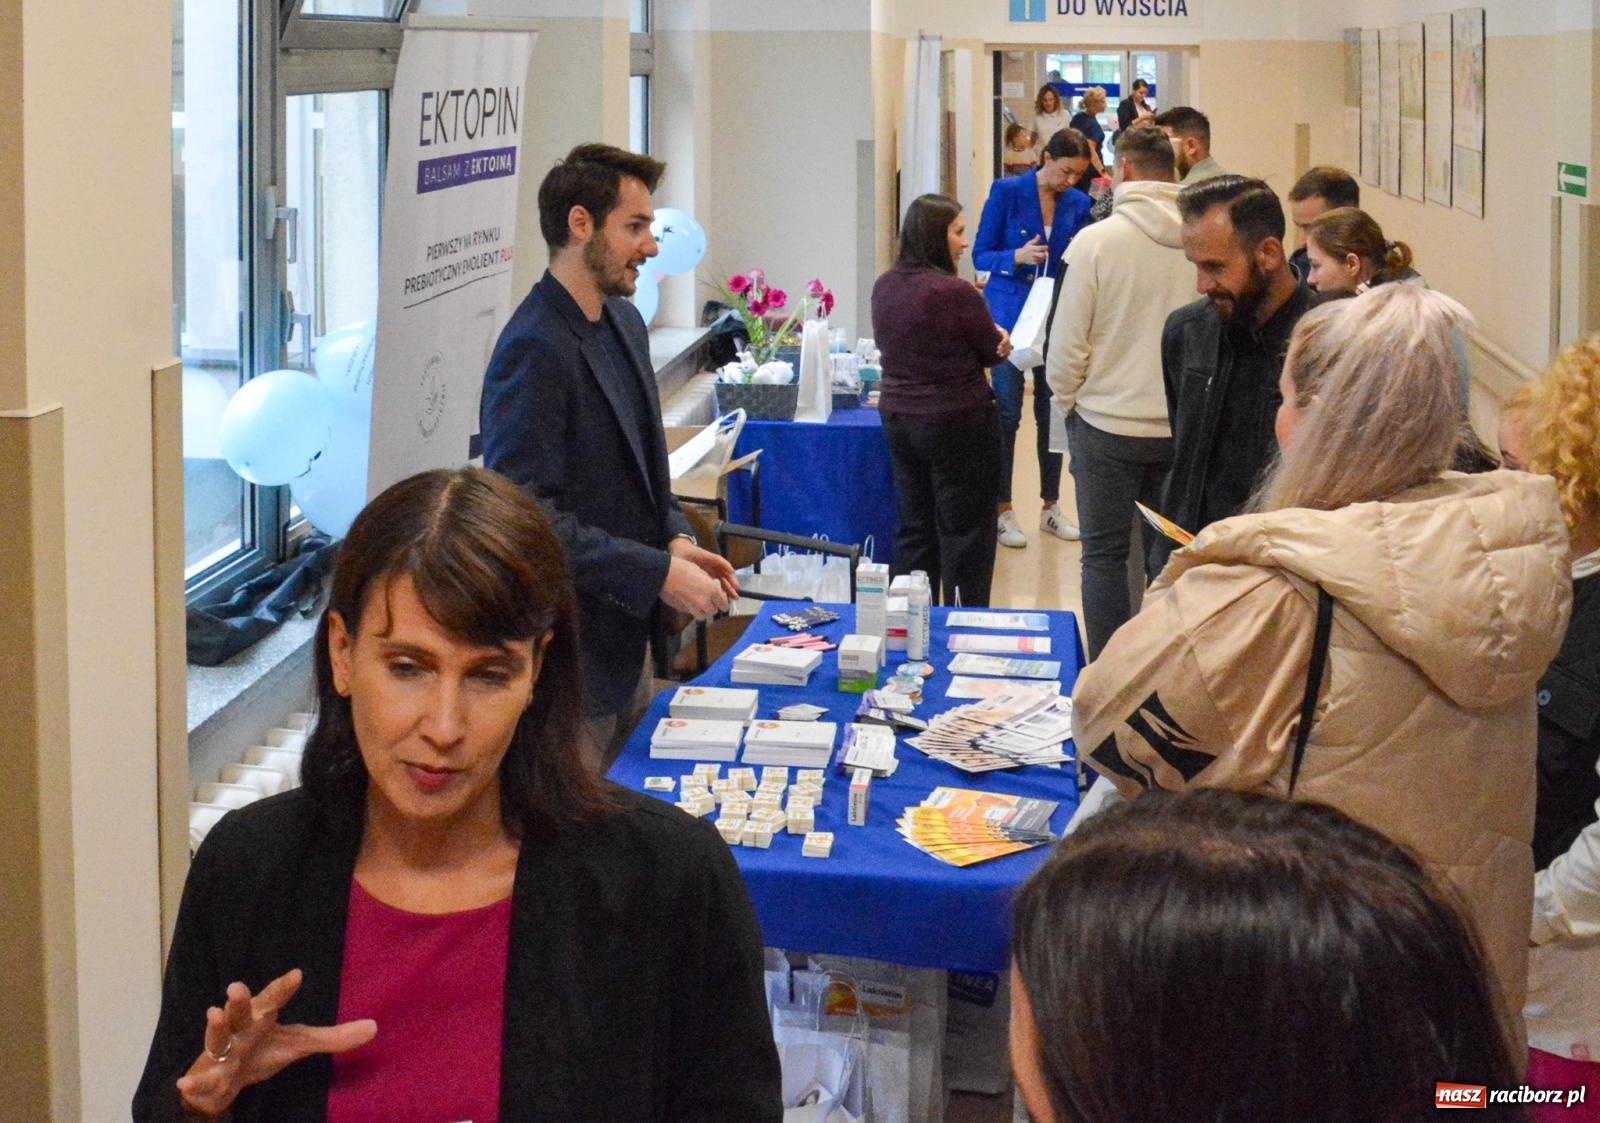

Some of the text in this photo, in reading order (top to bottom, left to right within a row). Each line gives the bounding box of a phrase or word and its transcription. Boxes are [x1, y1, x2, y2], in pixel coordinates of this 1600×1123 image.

[1057, 0, 1086, 15] DO
[419, 86, 520, 147] EKTOPIN
[424, 153, 513, 185] BALSAM Z EKTOINĄ
[426, 226, 501, 262] PIERWSZY NA RYNKU
[404, 261, 462, 295] PREBIOTYCZNY
[462, 250, 499, 276] EMOLIENT
